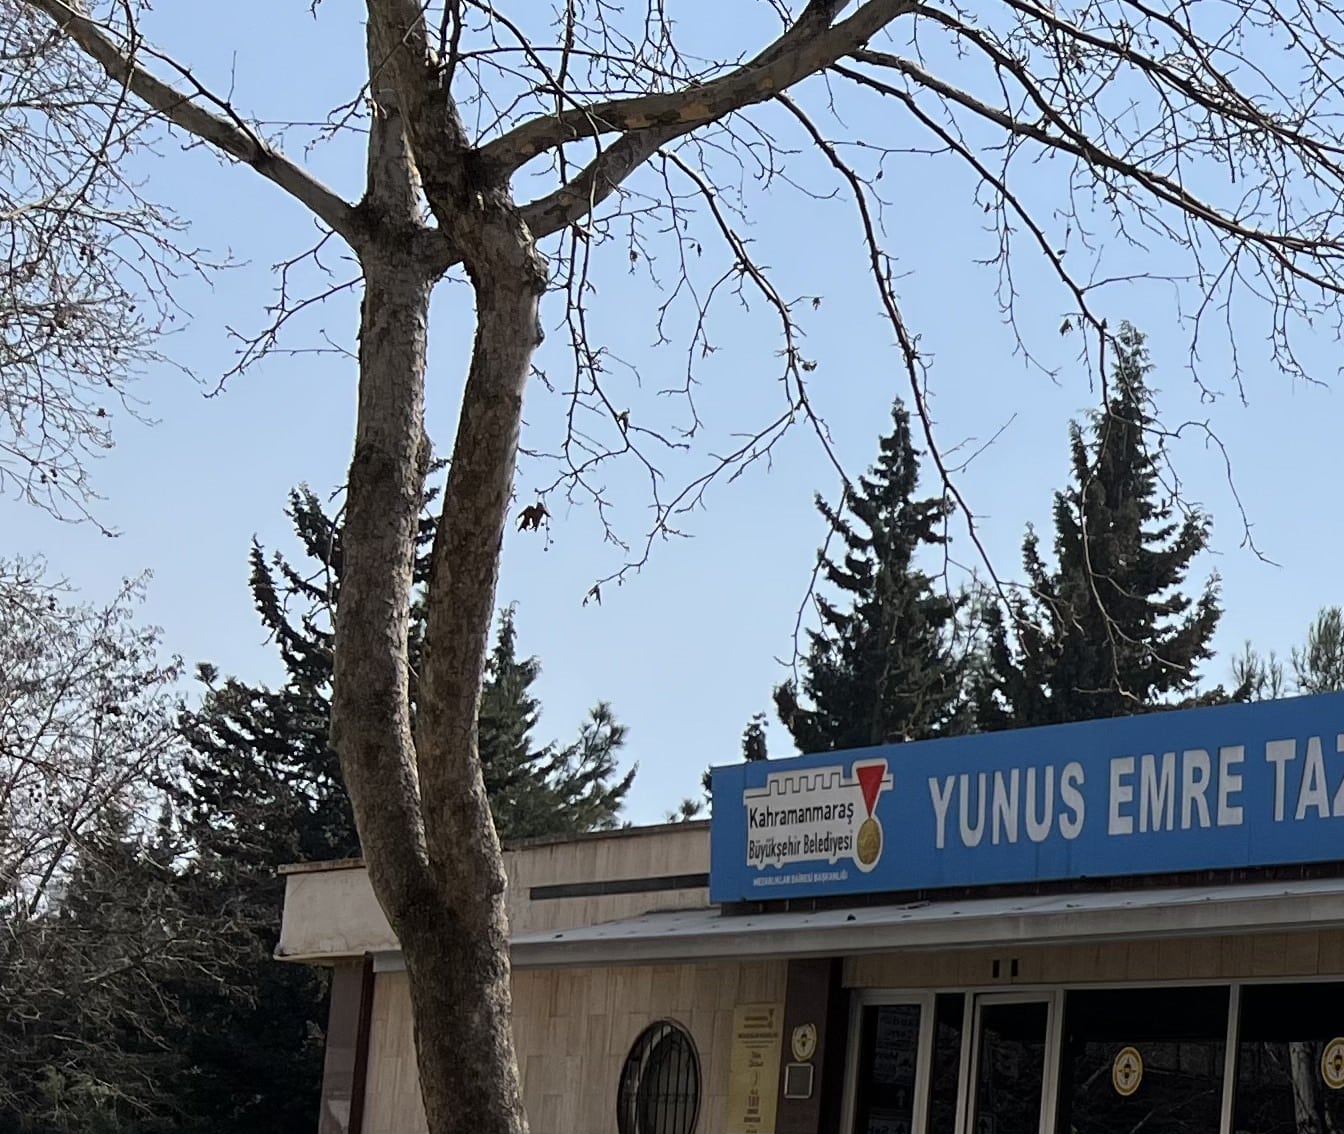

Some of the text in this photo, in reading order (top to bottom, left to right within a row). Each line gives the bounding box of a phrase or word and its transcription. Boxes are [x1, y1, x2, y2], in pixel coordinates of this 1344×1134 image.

[929, 763, 1085, 848] YUNUS
[1108, 746, 1244, 835] EMRE
[749, 802, 854, 828] Kahramanmaraş
[749, 830, 854, 864] Büyükşehir Belediyesi
